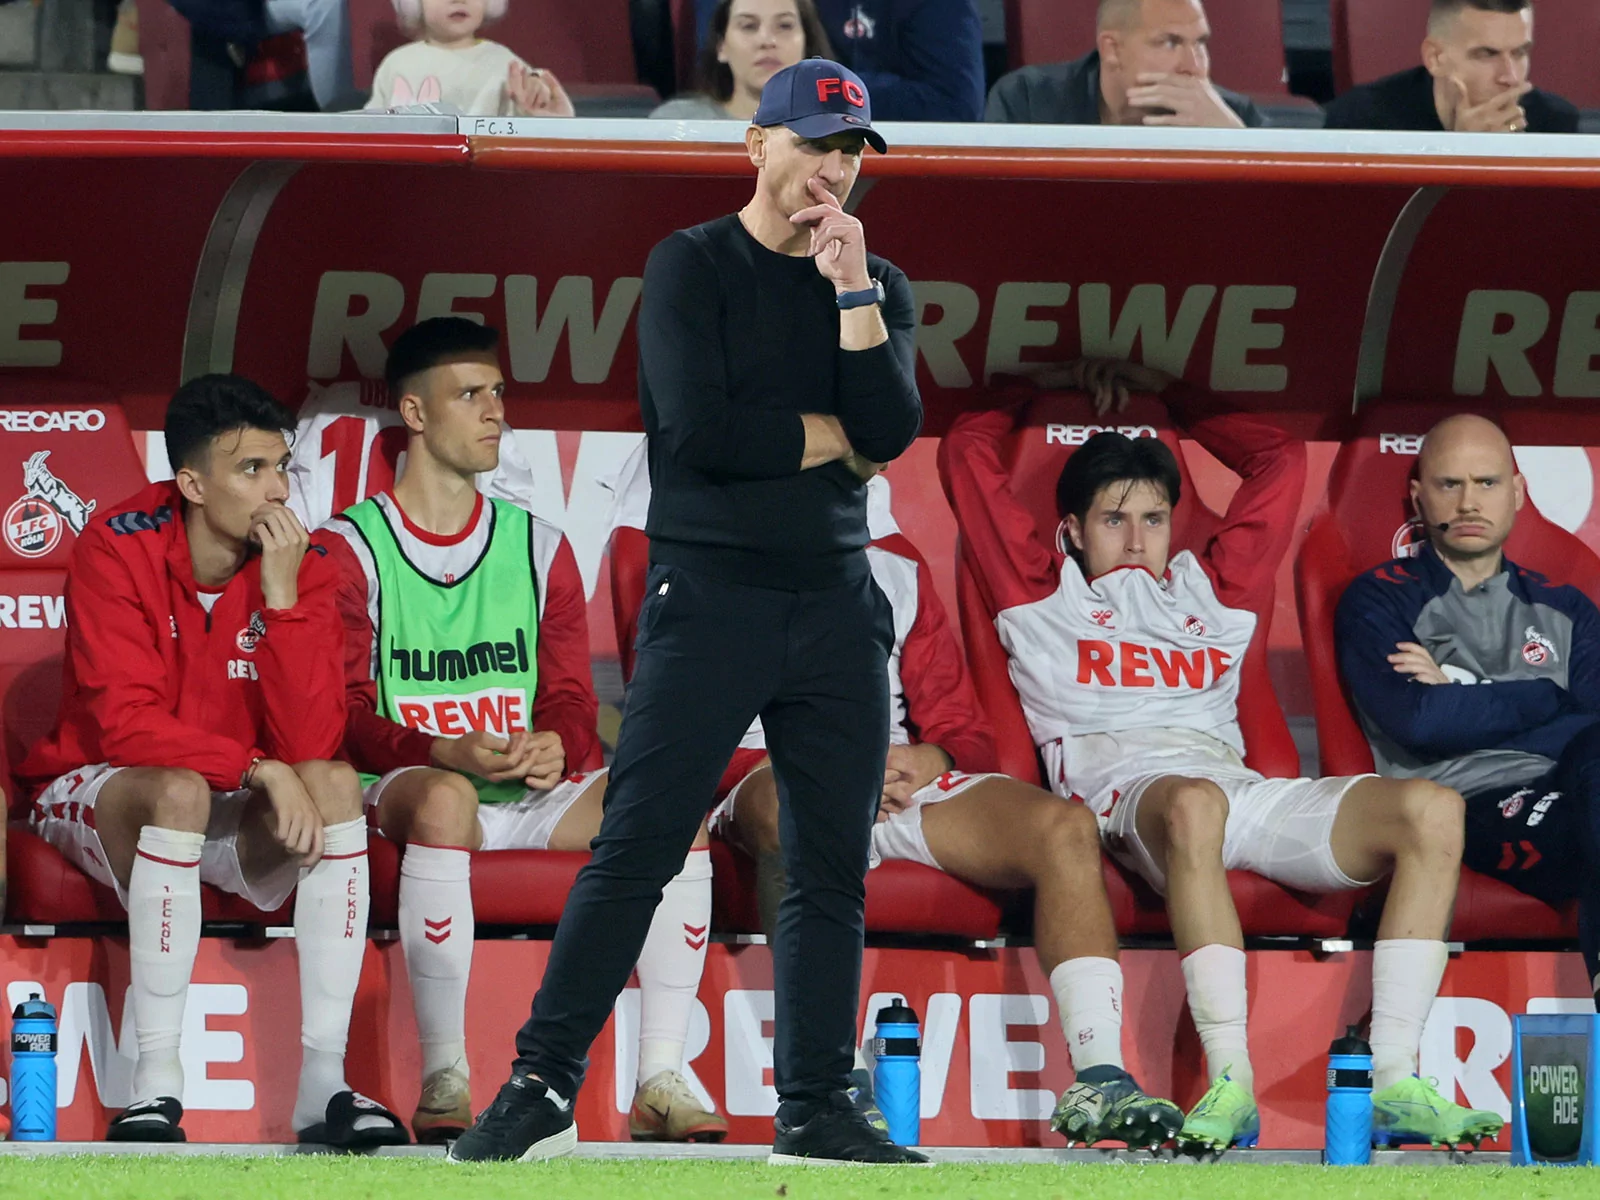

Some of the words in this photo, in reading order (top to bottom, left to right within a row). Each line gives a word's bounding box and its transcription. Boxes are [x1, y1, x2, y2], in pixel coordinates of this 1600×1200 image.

[816, 78, 865, 108] FC
[389, 627, 529, 682] hummel
[398, 695, 526, 736] REWE
[14, 1033, 52, 1044] POWER
[29, 1042, 52, 1052] ADE
[1529, 1064, 1579, 1095] POWER
[1552, 1095, 1579, 1125] ADE
